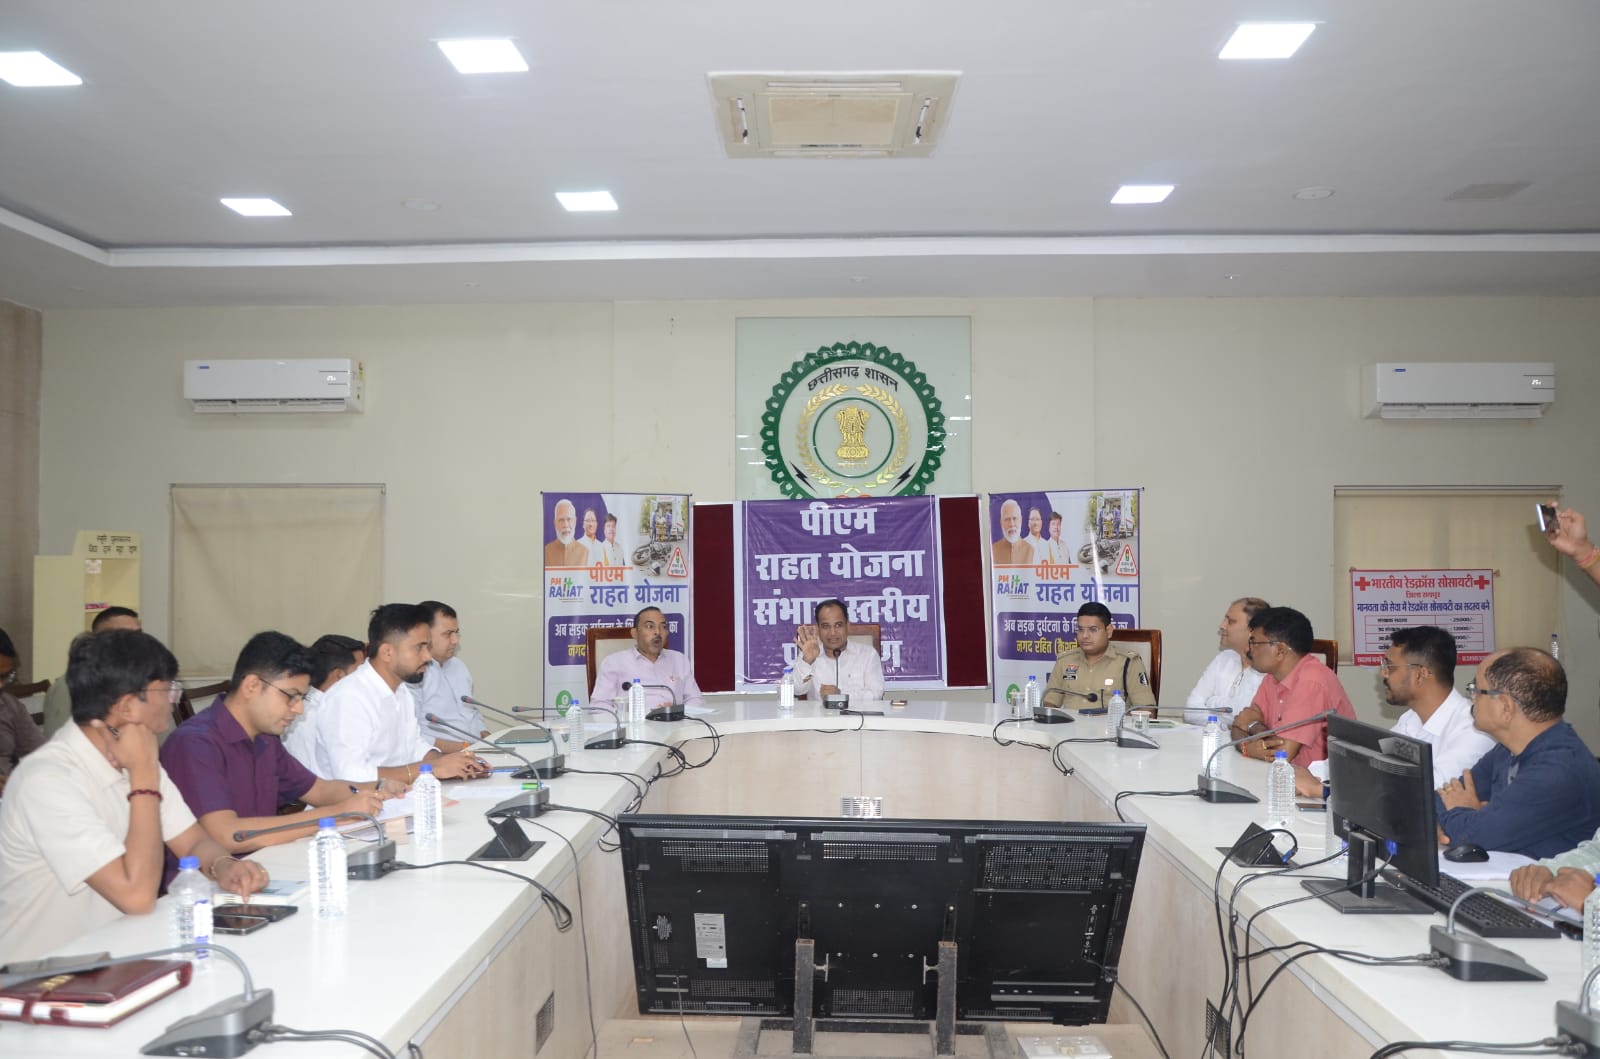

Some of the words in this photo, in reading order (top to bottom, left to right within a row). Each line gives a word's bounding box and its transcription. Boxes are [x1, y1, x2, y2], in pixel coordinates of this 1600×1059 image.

[864, 367, 898, 393] शासन
[800, 501, 878, 536] पीएम
[589, 561, 624, 582] पीएम
[754, 552, 822, 581] राहत
[828, 543, 926, 579] योजना
[1035, 559, 1070, 581] पीएम
[589, 584, 629, 607] राहत
[634, 578, 688, 604] योजना
[1371, 574, 1403, 589] भारतीय
[752, 588, 837, 626] संभा
[844, 586, 930, 624] स्तरीय
[1035, 583, 1076, 606] राहत
[554, 623, 567, 637] अब
[1003, 619, 1016, 632] अब
[1062, 616, 1070, 633] के
